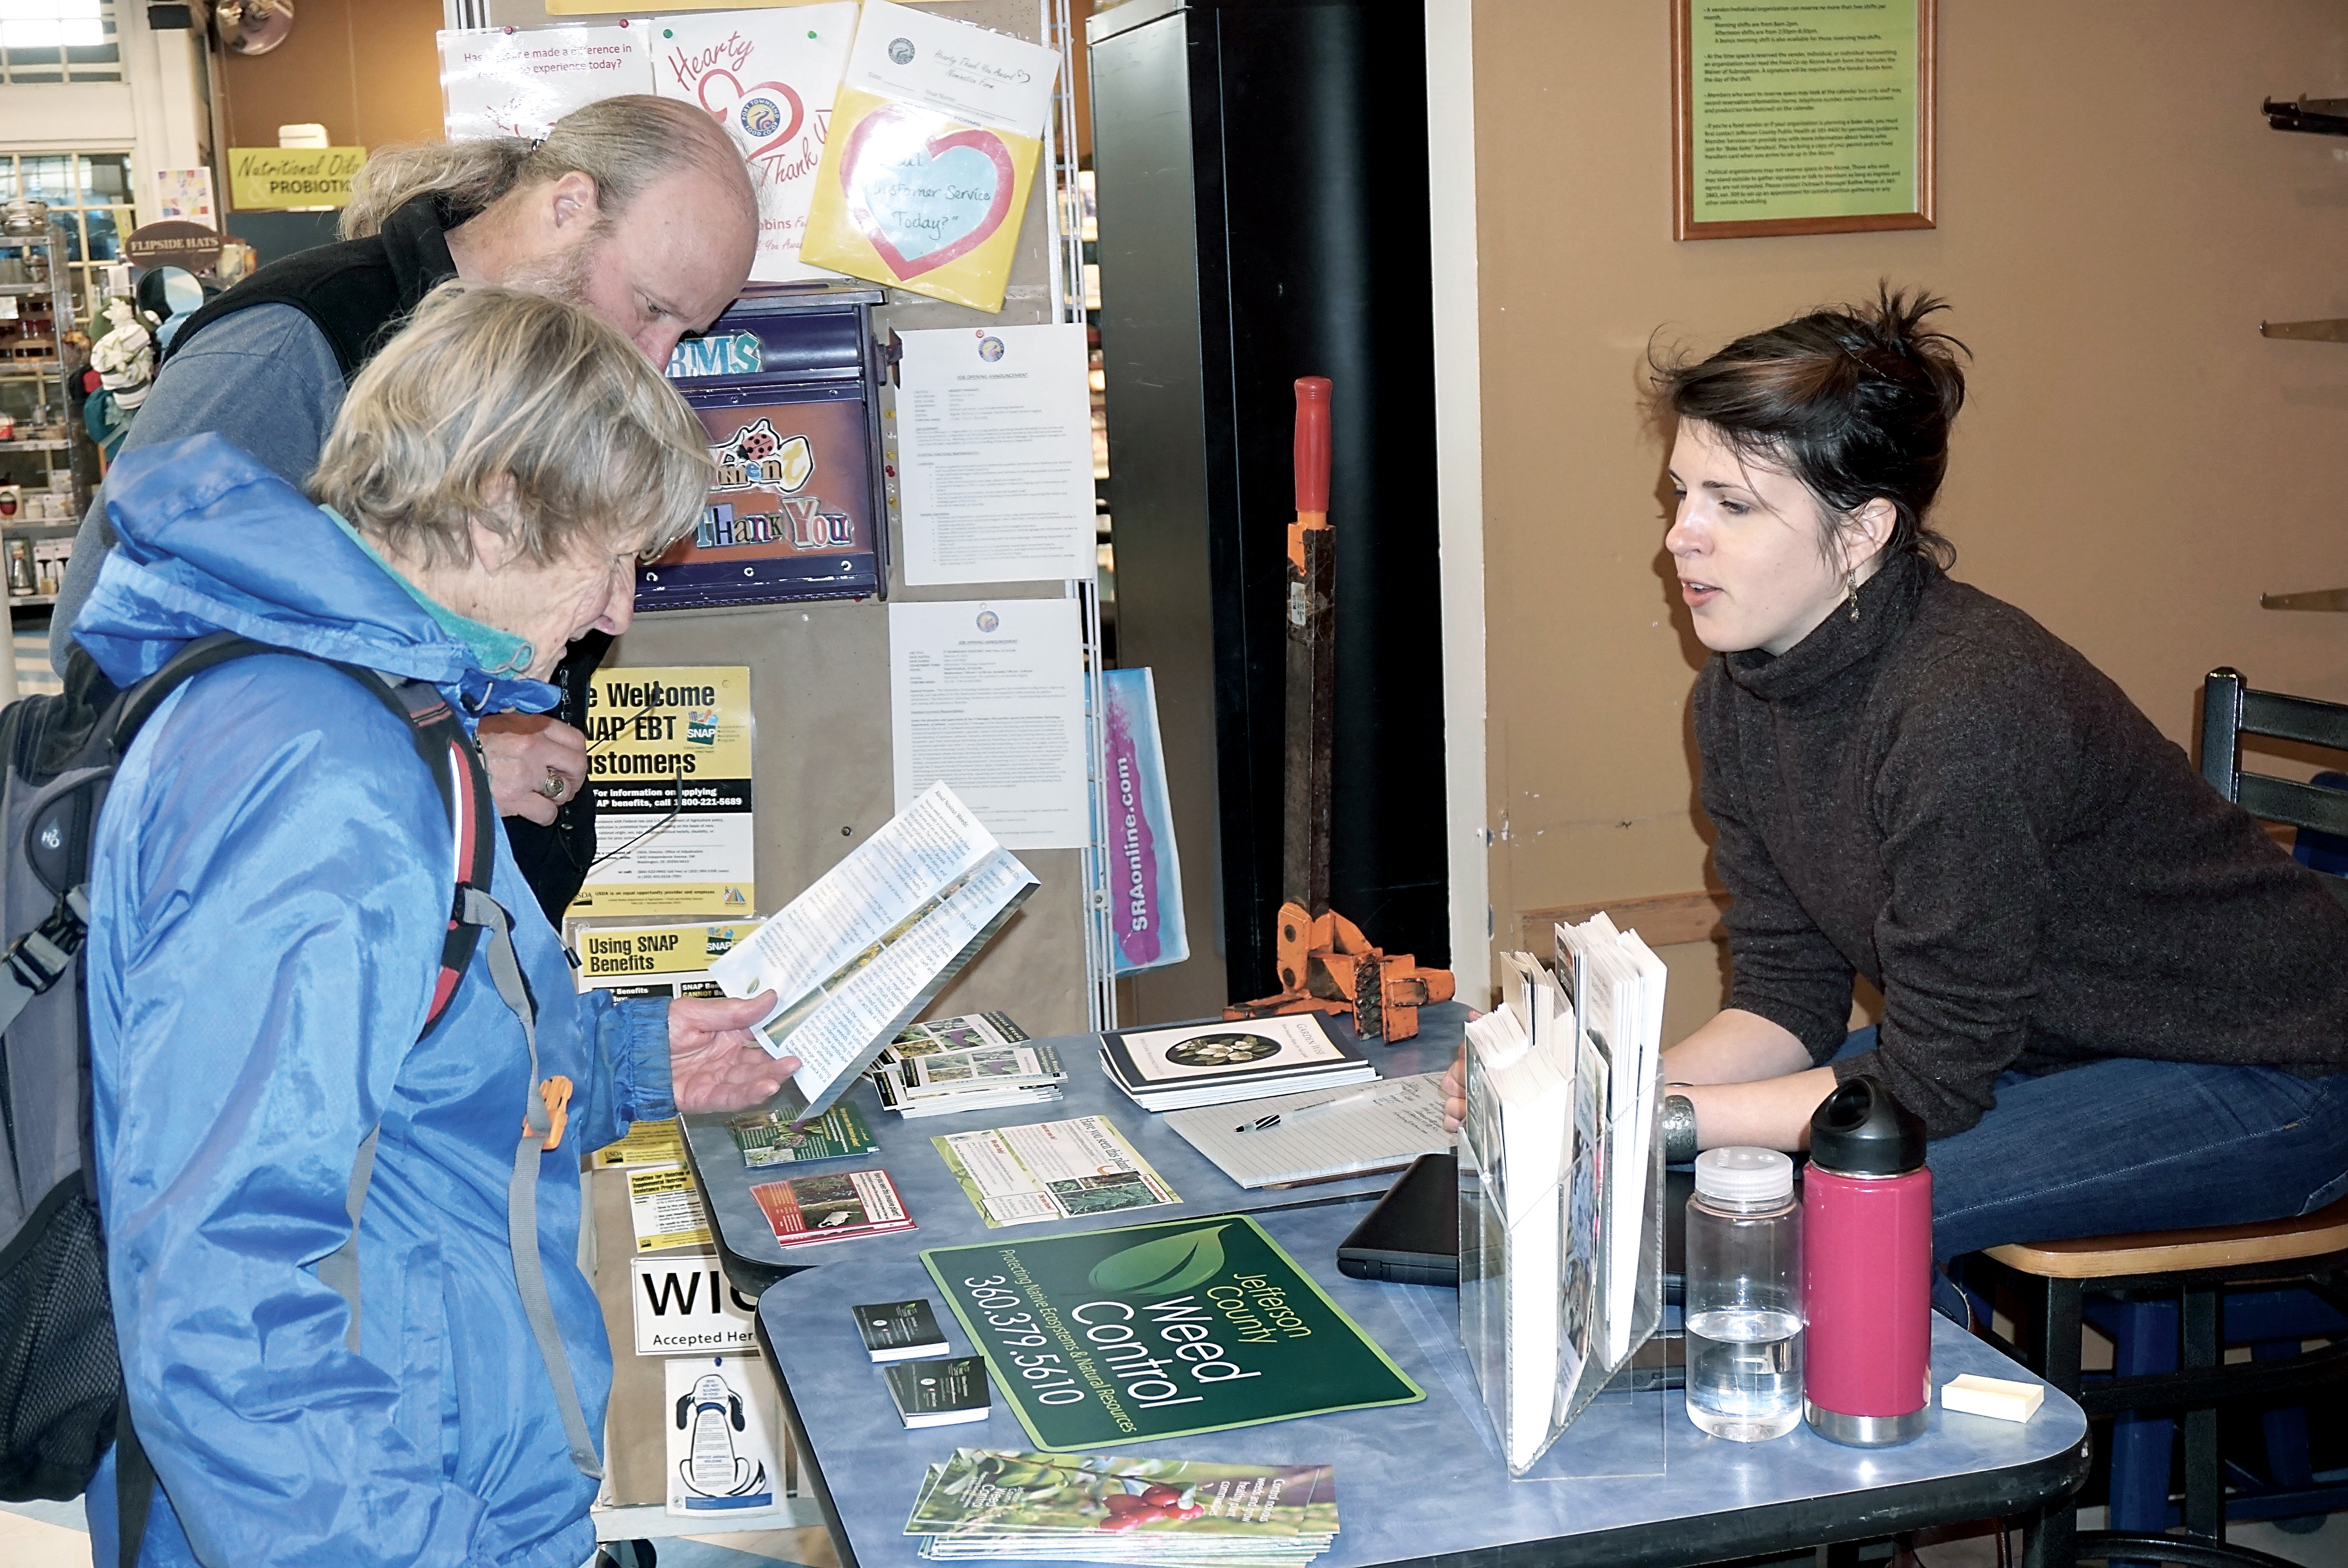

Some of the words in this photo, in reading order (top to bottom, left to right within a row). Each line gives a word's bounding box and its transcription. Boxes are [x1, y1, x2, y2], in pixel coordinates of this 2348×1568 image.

[464, 53, 482, 62] Has
[533, 48, 560, 58] made
[623, 44, 632, 53] in
[668, 31, 754, 91] Hearty
[533, 63, 586, 74] experience
[589, 59, 622, 70] today?
[934, 50, 957, 65] Hearty
[959, 56, 982, 70] Thank
[981, 63, 992, 75] You
[993, 68, 1017, 81] Award
[946, 69, 979, 84] Nomination
[978, 78, 994, 90] Form
[742, 104, 751, 120] PORT
[750, 99, 779, 118] TOWNSEND
[745, 125, 761, 136] FOOD
[763, 122, 778, 136] CO-OP
[954, 115, 982, 127] FORMS
[238, 154, 326, 177] Nutritional
[761, 137, 817, 187] Thank
[945, 184, 991, 200] Service
[892, 211, 959, 240] Today?"
[131, 238, 185, 252] FLIPSIDE
[186, 236, 219, 249] HATS
[667, 333, 760, 377] RMS
[782, 498, 851, 545] You
[606, 682, 715, 708] Welcome
[586, 716, 625, 741] NAP
[635, 716, 677, 741] EBT
[687, 728, 715, 738] SNAP
[587, 751, 696, 775] stomers
[610, 788, 662, 797] information
[681, 788, 717, 797] pplying
[611, 798, 652, 808] benefits,
[655, 798, 671, 807] call
[673, 797, 742, 806] 1800-221-5689
[935, 791, 946, 802] About
[945, 800, 957, 815] Noxious
[956, 813, 969, 828] Weeds:
[1118, 757, 1148, 932] SRAonline.com
[966, 920, 977, 932] cycle
[589, 938, 632, 955] Using
[637, 935, 678, 953] SNAP
[706, 941, 732, 952] SNAP
[590, 955, 654, 973] Benefits
[837, 994, 852, 1014] Mitigating
[857, 1017, 869, 1032] impact
[810, 1020, 821, 1033] impact
[831, 1043, 848, 1064] landscape
[1008, 1027, 1024, 1041] Weeds
[1296, 1024, 1315, 1045] GARDEN
[1310, 1044, 1326, 1055] WISE
[794, 1046, 811, 1065] landscape
[810, 1064, 819, 1075] back
[1079, 1117, 1096, 1129] Have
[1085, 1129, 1103, 1139] you
[1096, 1138, 1112, 1149] seen
[1105, 1149, 1123, 1158] this
[1109, 1157, 1137, 1171] plant?
[632, 1180, 665, 1188] Supplemental
[634, 1186, 660, 1194] Assistance
[884, 1195, 896, 1207] invasive
[888, 1206, 902, 1216] plant?
[998, 1249, 1032, 1286] Protecting
[1023, 1283, 1048, 1310] Native
[1233, 1273, 1312, 1339] Jefferson
[1206, 1286, 1278, 1344] County
[653, 1332, 722, 1347] Accepted
[727, 1330, 754, 1342] Her
[1039, 1307, 1079, 1351] Ecosystems
[1142, 1295, 1262, 1384] Weed
[964, 1275, 1085, 1406] 360.379.5610
[1070, 1350, 1080, 1359] &
[1071, 1301, 1204, 1409] Control
[1073, 1357, 1102, 1390] Natural
[1096, 1386, 1137, 1433] Resources
[971, 1484, 996, 1508] Control
[1229, 1481, 1251, 1502] healthy
[1252, 1477, 1266, 1495] weeds
[1268, 1478, 1286, 1500] Control
[985, 1487, 1008, 1507] Weed
[1248, 1495, 1260, 1507] and
[1226, 1502, 1242, 1517] plant
[1242, 1507, 1255, 1523] grow
[1259, 1500, 1275, 1522] noxious
